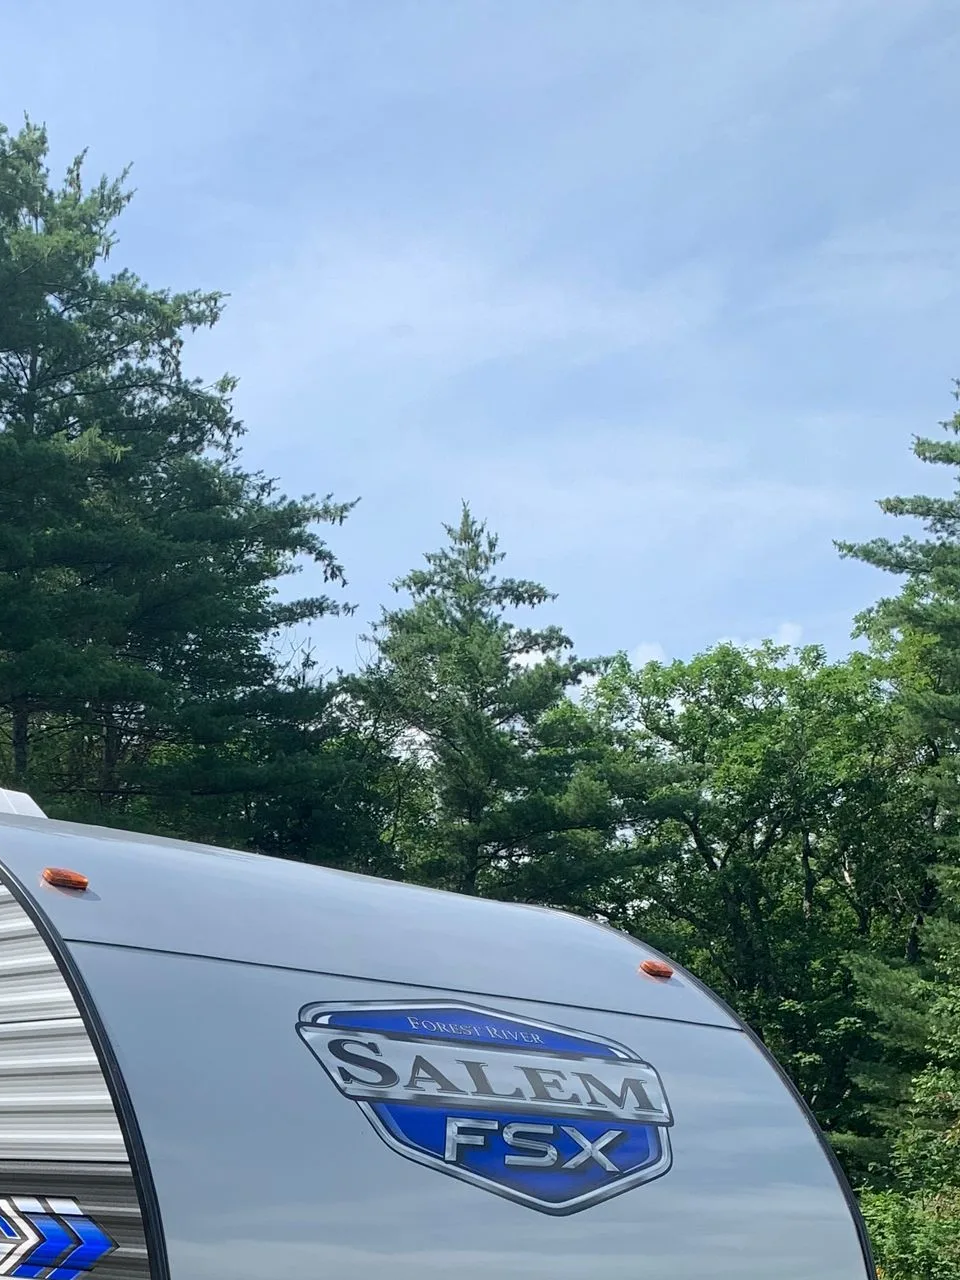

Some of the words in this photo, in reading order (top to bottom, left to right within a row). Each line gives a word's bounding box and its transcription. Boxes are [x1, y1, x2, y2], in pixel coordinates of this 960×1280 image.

[406, 1016, 481, 1037] FOREST
[485, 1025, 544, 1045] RIVER
[326, 1038, 665, 1114] SALEM
[443, 1116, 625, 1174] FSX
